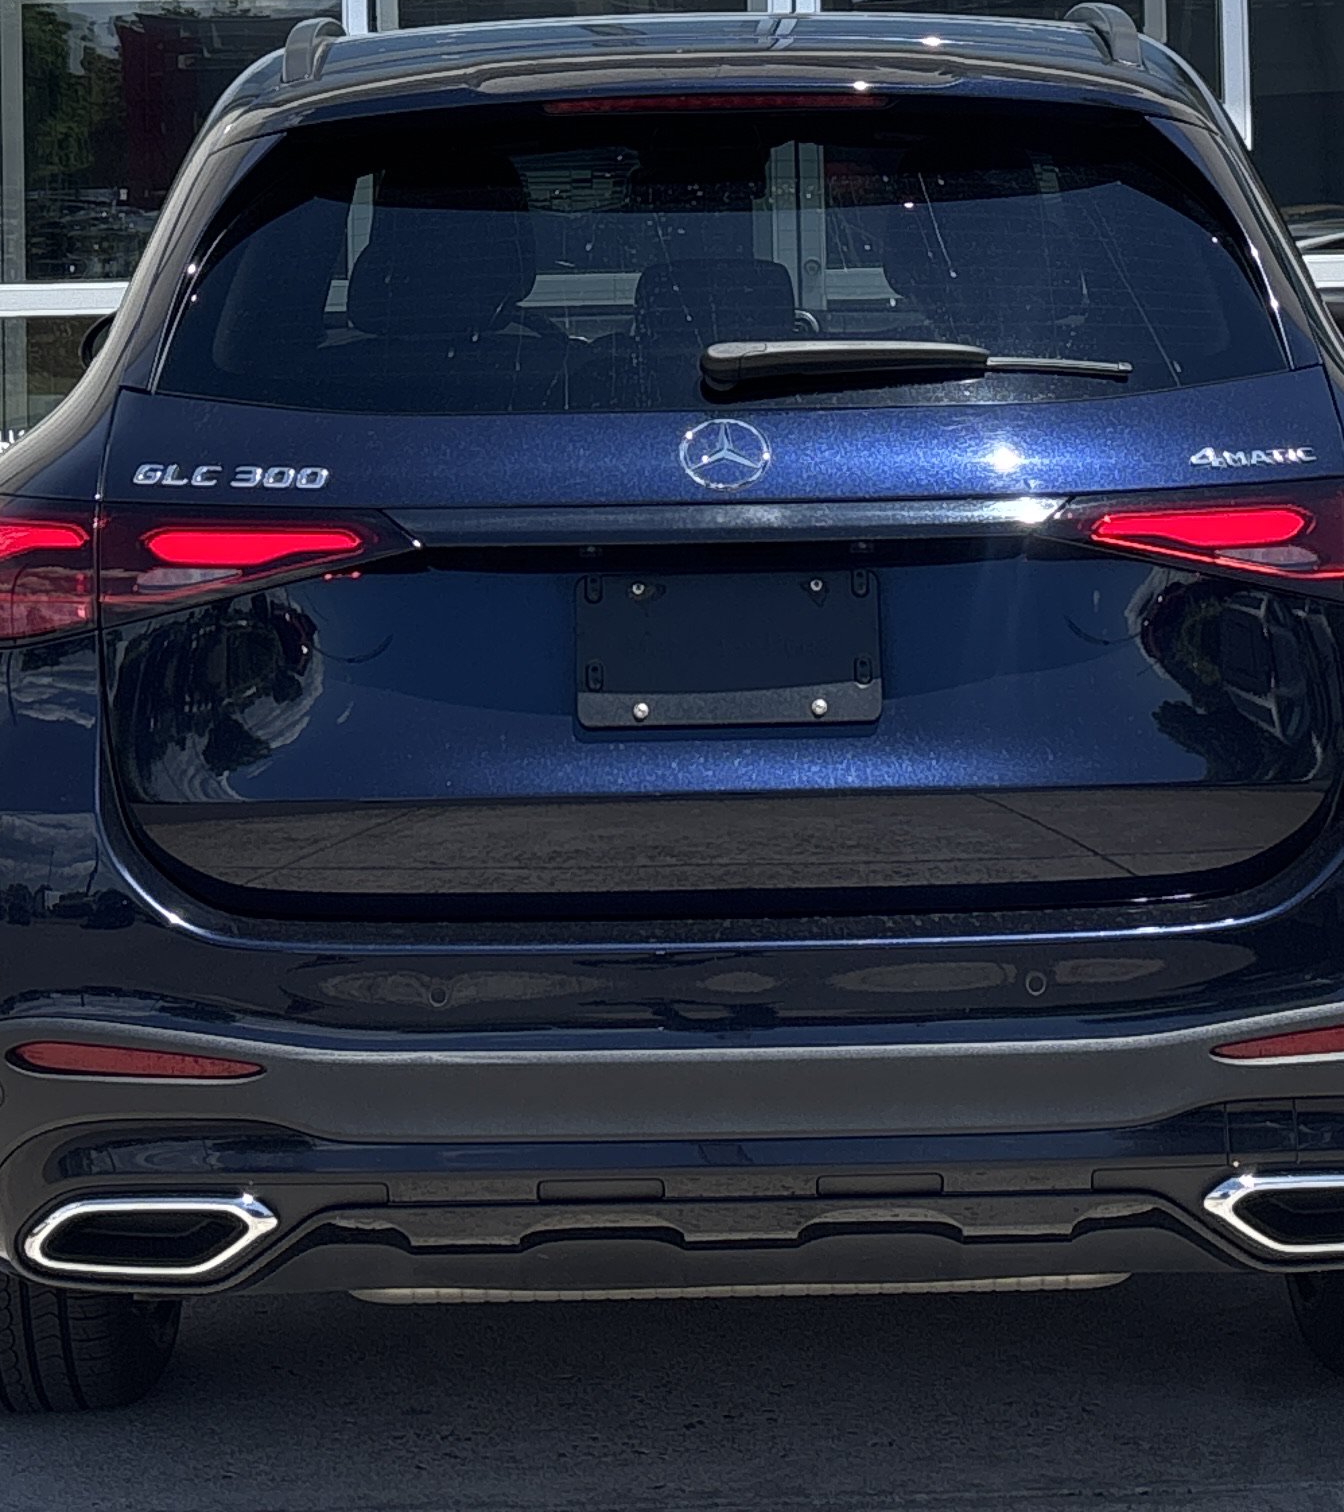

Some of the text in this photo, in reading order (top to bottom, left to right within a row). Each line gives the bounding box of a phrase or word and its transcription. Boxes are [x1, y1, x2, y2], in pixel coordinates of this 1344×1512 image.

[1189, 446, 1317, 469] 4MATIC
[132, 463, 330, 489] GLC 300
